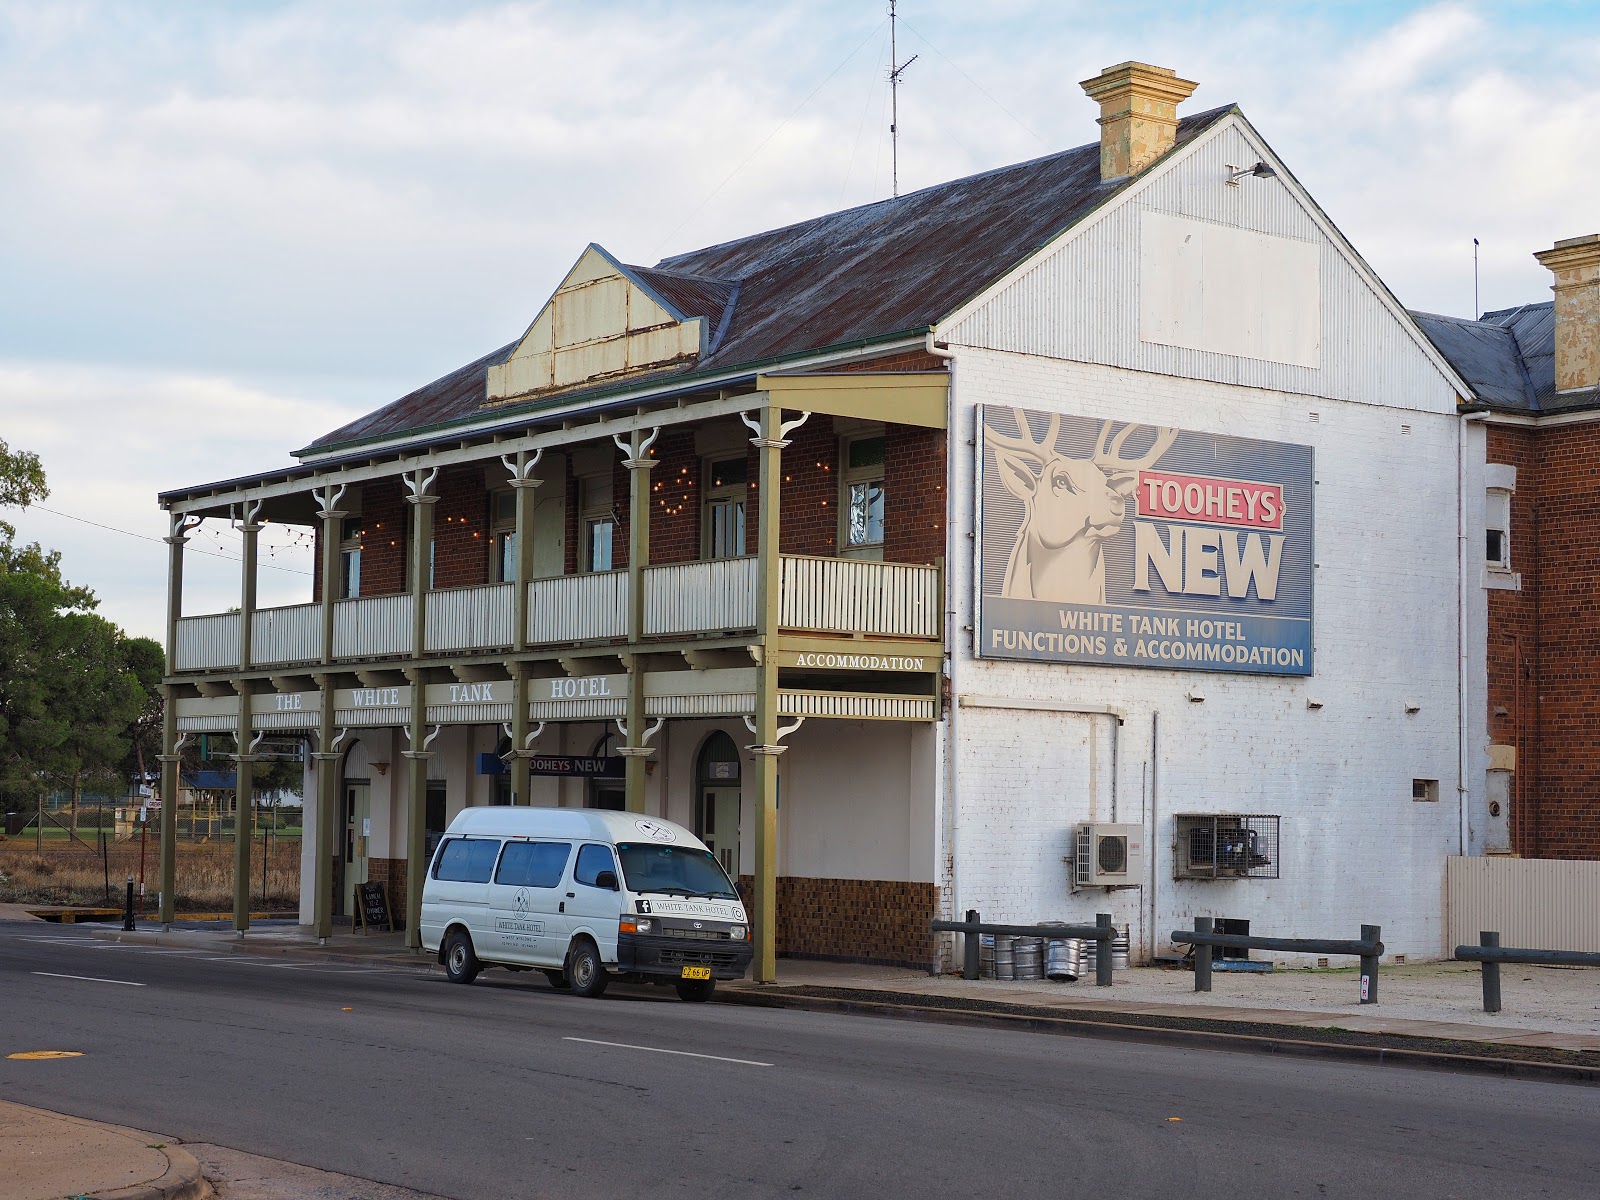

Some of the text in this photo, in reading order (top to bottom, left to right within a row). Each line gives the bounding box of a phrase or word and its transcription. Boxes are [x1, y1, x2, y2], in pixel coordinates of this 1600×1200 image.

[1143, 478, 1277, 522] TOOHEYS
[1132, 521, 1287, 601] NEW
[1059, 610, 1247, 641] WHITE TANK HOTEL
[796, 653, 924, 671] ACCOMMODATION
[991, 629, 1304, 667] FUNCTIONS & ACCOMMODATION
[275, 677, 610, 710] THE WHITE TANK HOTEL
[529, 759, 606, 773] OOHEYS NEW
[656, 903, 729, 915] WHITE TANK HOTEL
[498, 922, 542, 932] WHITE TANK HOTEL
